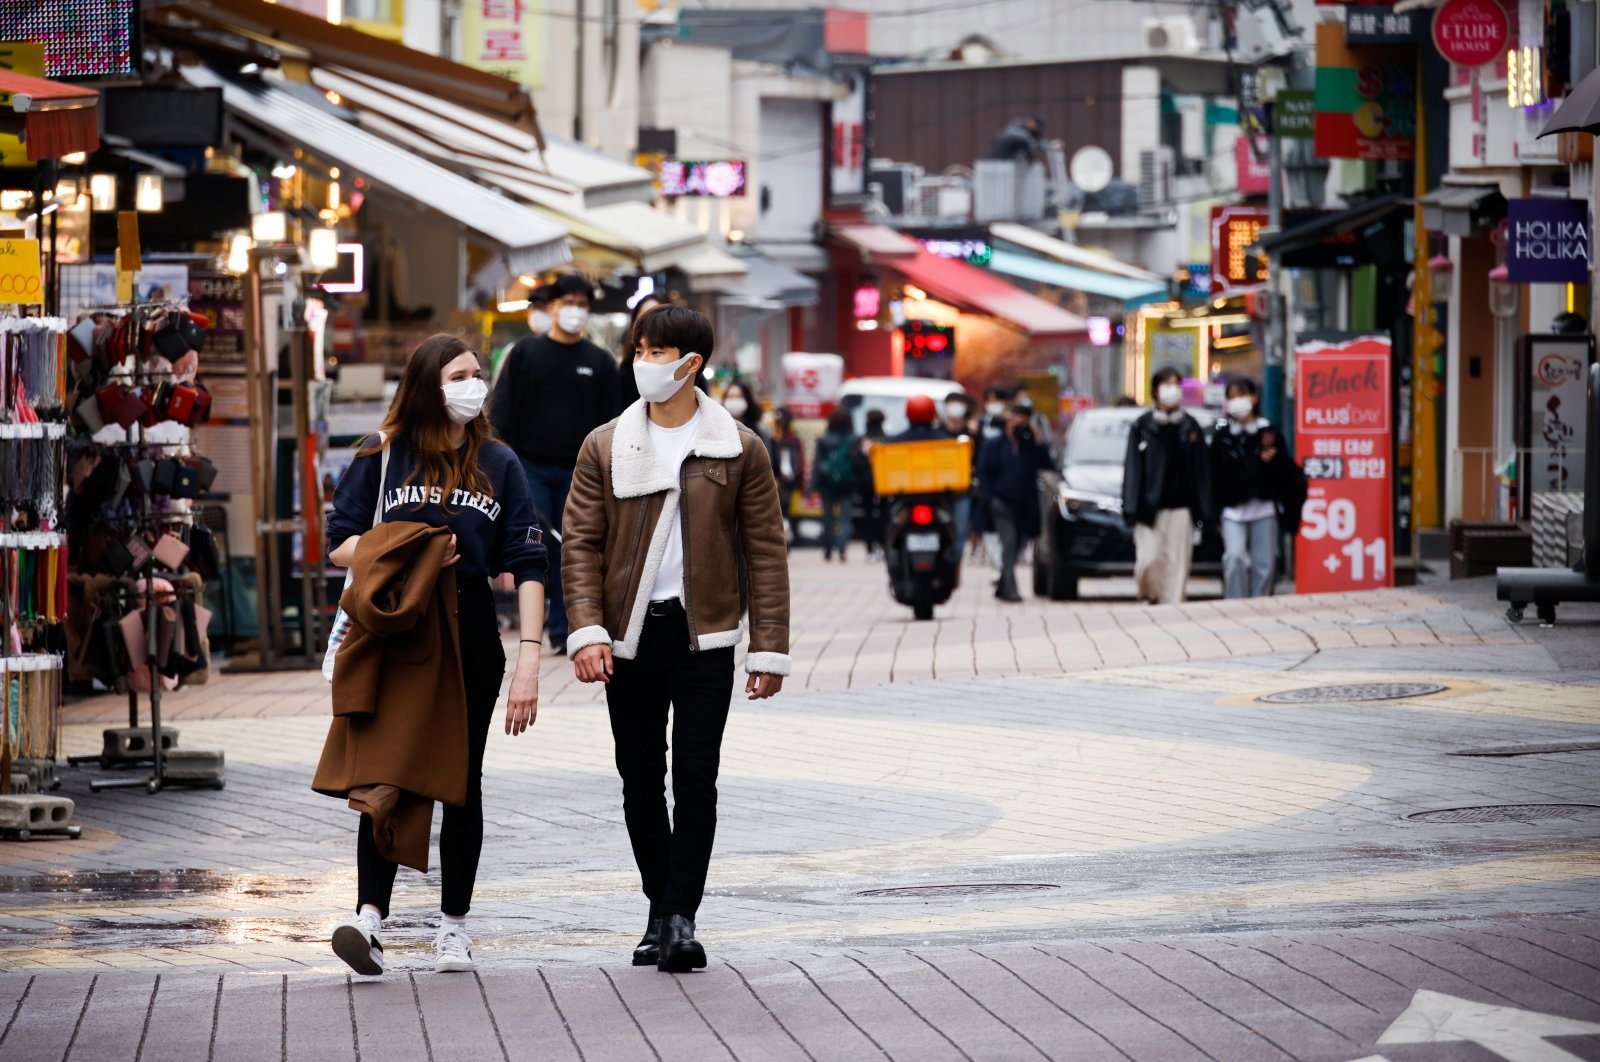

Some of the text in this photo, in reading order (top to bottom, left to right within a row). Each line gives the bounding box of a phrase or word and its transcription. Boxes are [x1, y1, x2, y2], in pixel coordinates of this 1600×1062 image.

[1442, 23, 1500, 39] ETUDE
[1450, 40, 1491, 51] HOUSE
[1516, 221, 1588, 240] HOLIKA
[1516, 240, 1588, 260] HOLIKA
[1308, 360, 1380, 400] Black
[1344, 438, 1373, 456] 대상
[1304, 457, 1386, 479] 추가 할인
[384, 485, 501, 522] ALWAYS TIRED
